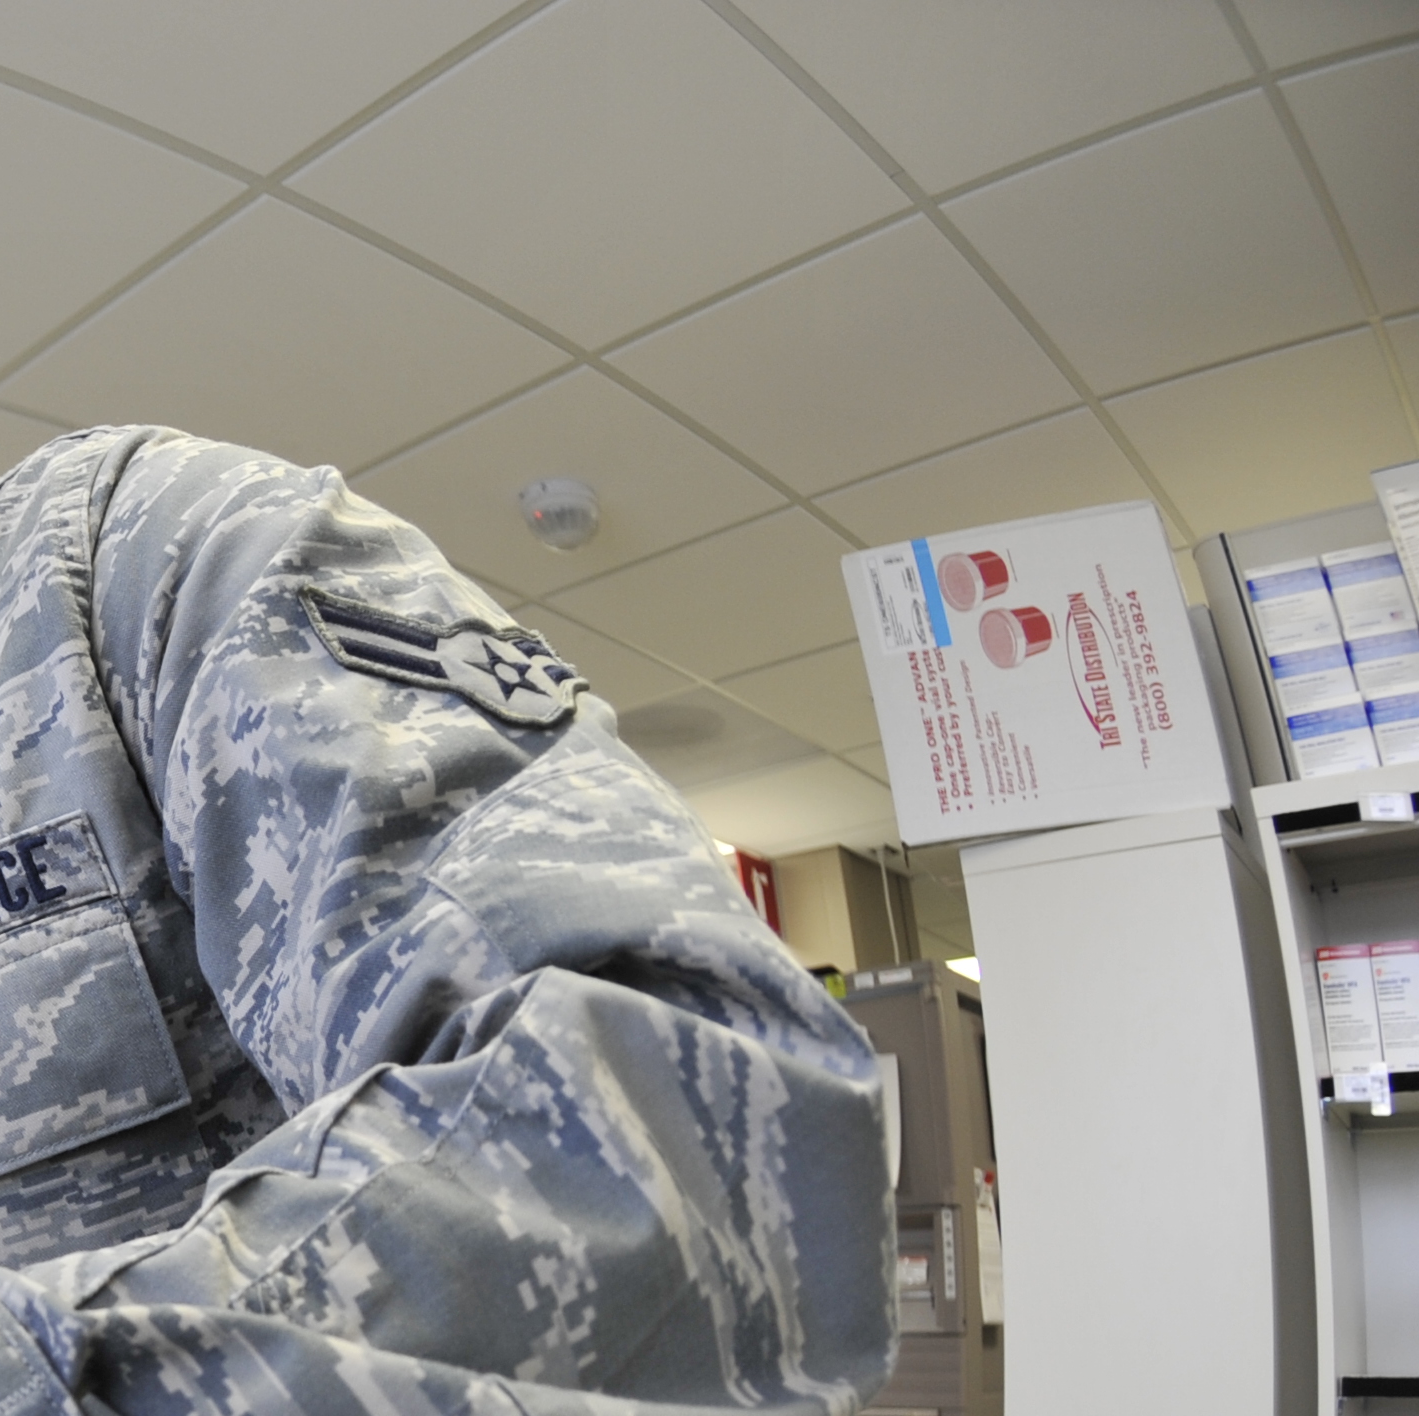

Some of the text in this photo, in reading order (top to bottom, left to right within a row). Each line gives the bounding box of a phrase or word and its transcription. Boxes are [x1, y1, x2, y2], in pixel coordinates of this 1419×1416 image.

[1096, 564, 1121, 639] prescription
[1116, 645, 1125, 655] in
[1127, 590, 1172, 730] (800) 392-9824
[1067, 592, 1121, 749] TRI STATE DISTRIBUTION
[1121, 661, 1136, 700] leader
[929, 687, 941, 710] vial
[941, 678, 956, 707] your
[1134, 664, 1155, 731] packaging
[946, 712, 960, 730] by
[1133, 706, 1144, 733] new
[936, 715, 956, 767] cap-one
[930, 753, 944, 781] PRO
[951, 734, 974, 796] Preferred
[947, 772, 961, 798] One
[937, 788, 950, 813] THE
